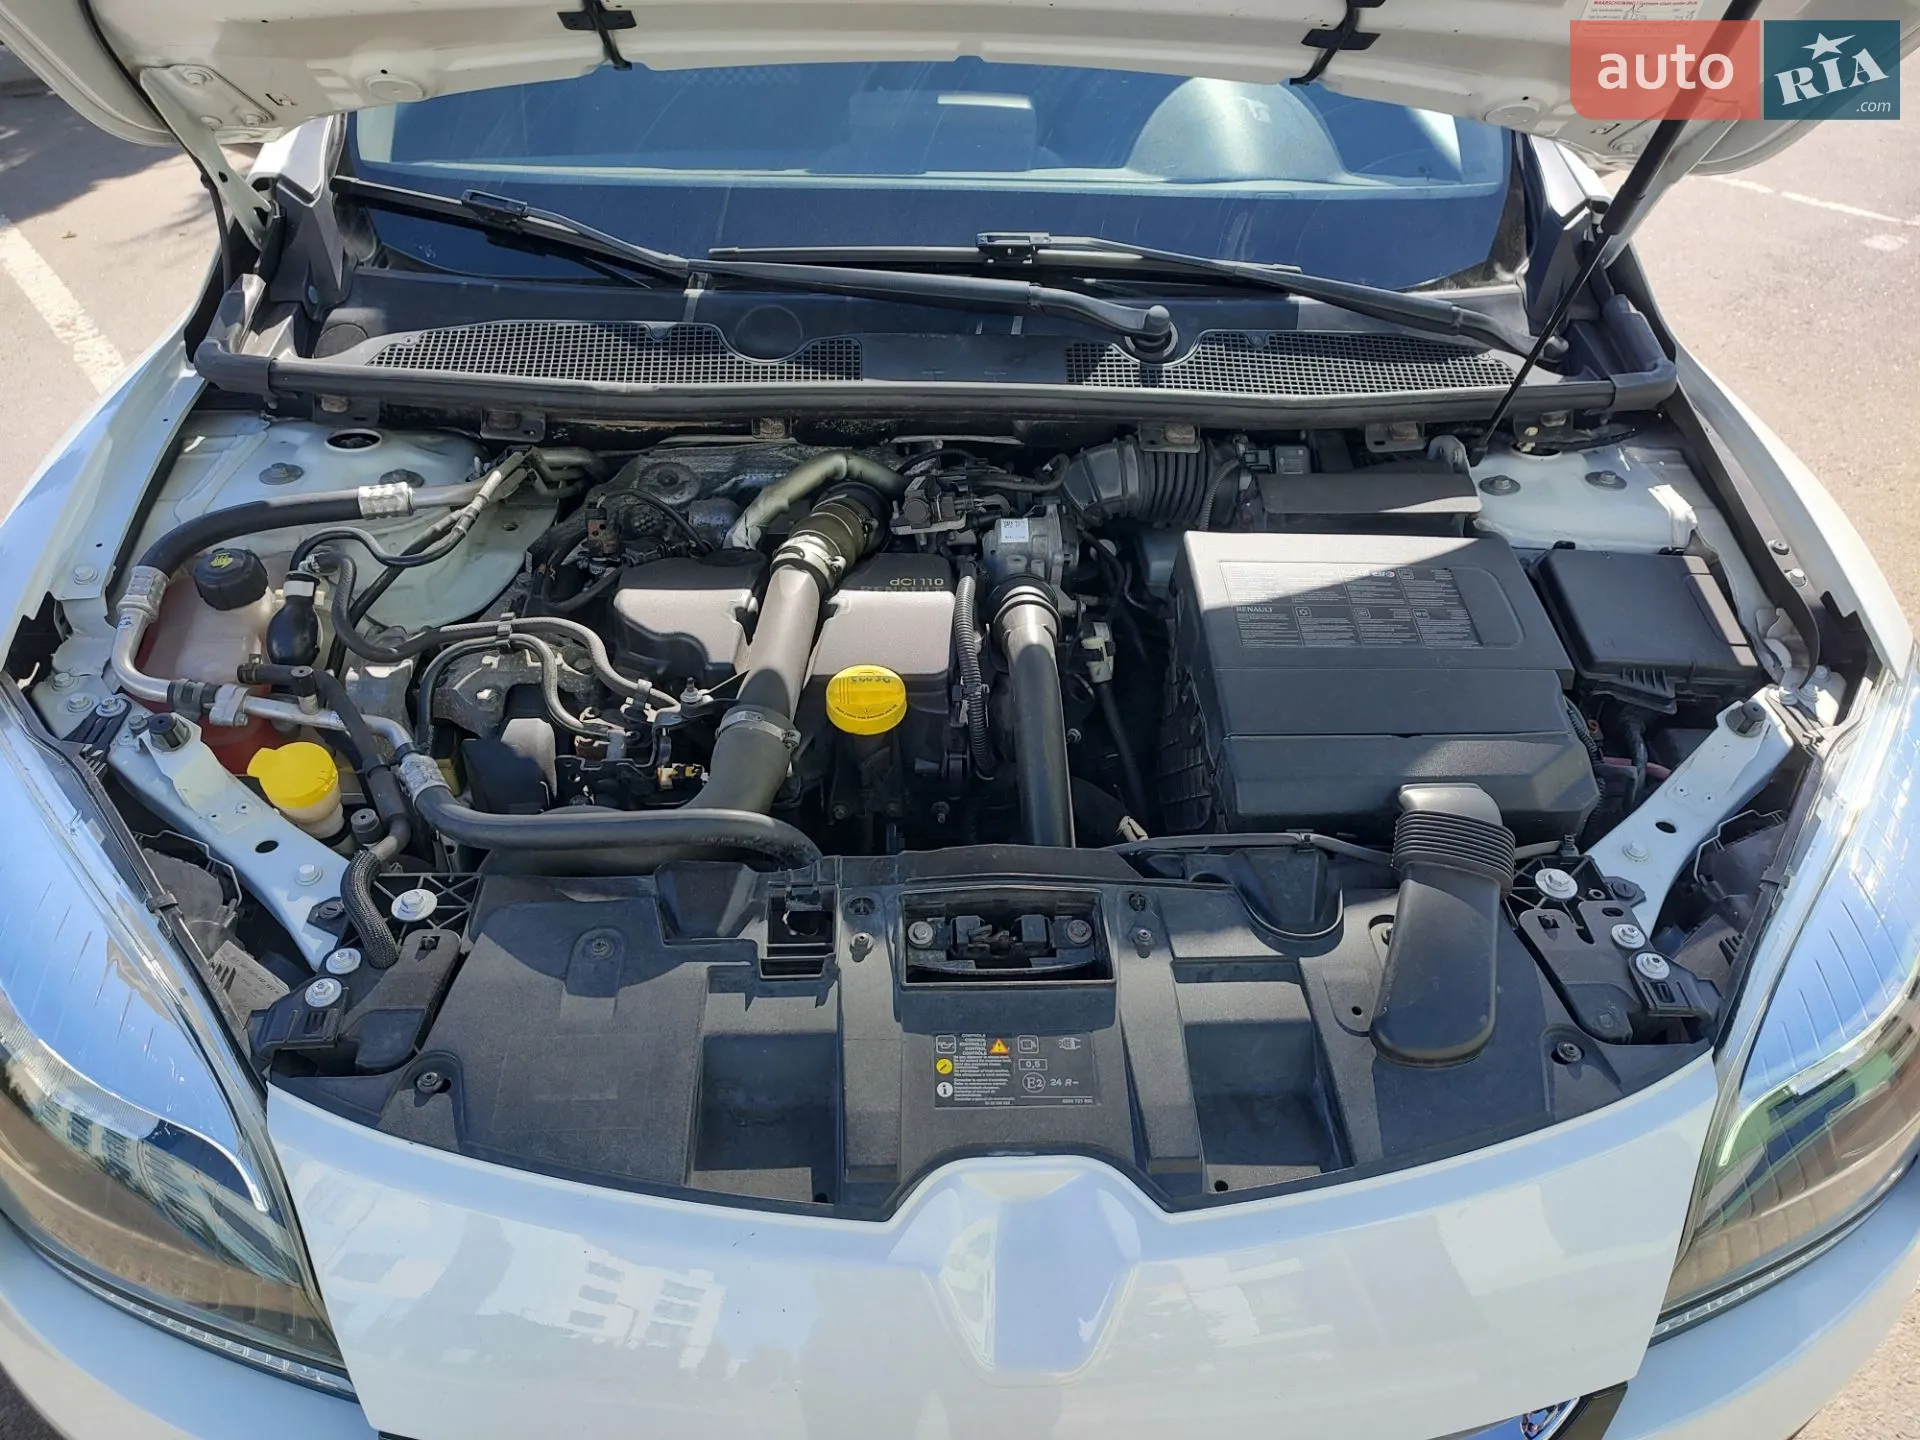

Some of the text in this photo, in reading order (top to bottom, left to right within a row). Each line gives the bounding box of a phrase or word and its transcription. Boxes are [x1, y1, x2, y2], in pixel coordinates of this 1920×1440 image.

[889, 578, 944, 586] dCi 110
[1050, 1078, 1063, 1087] 24
